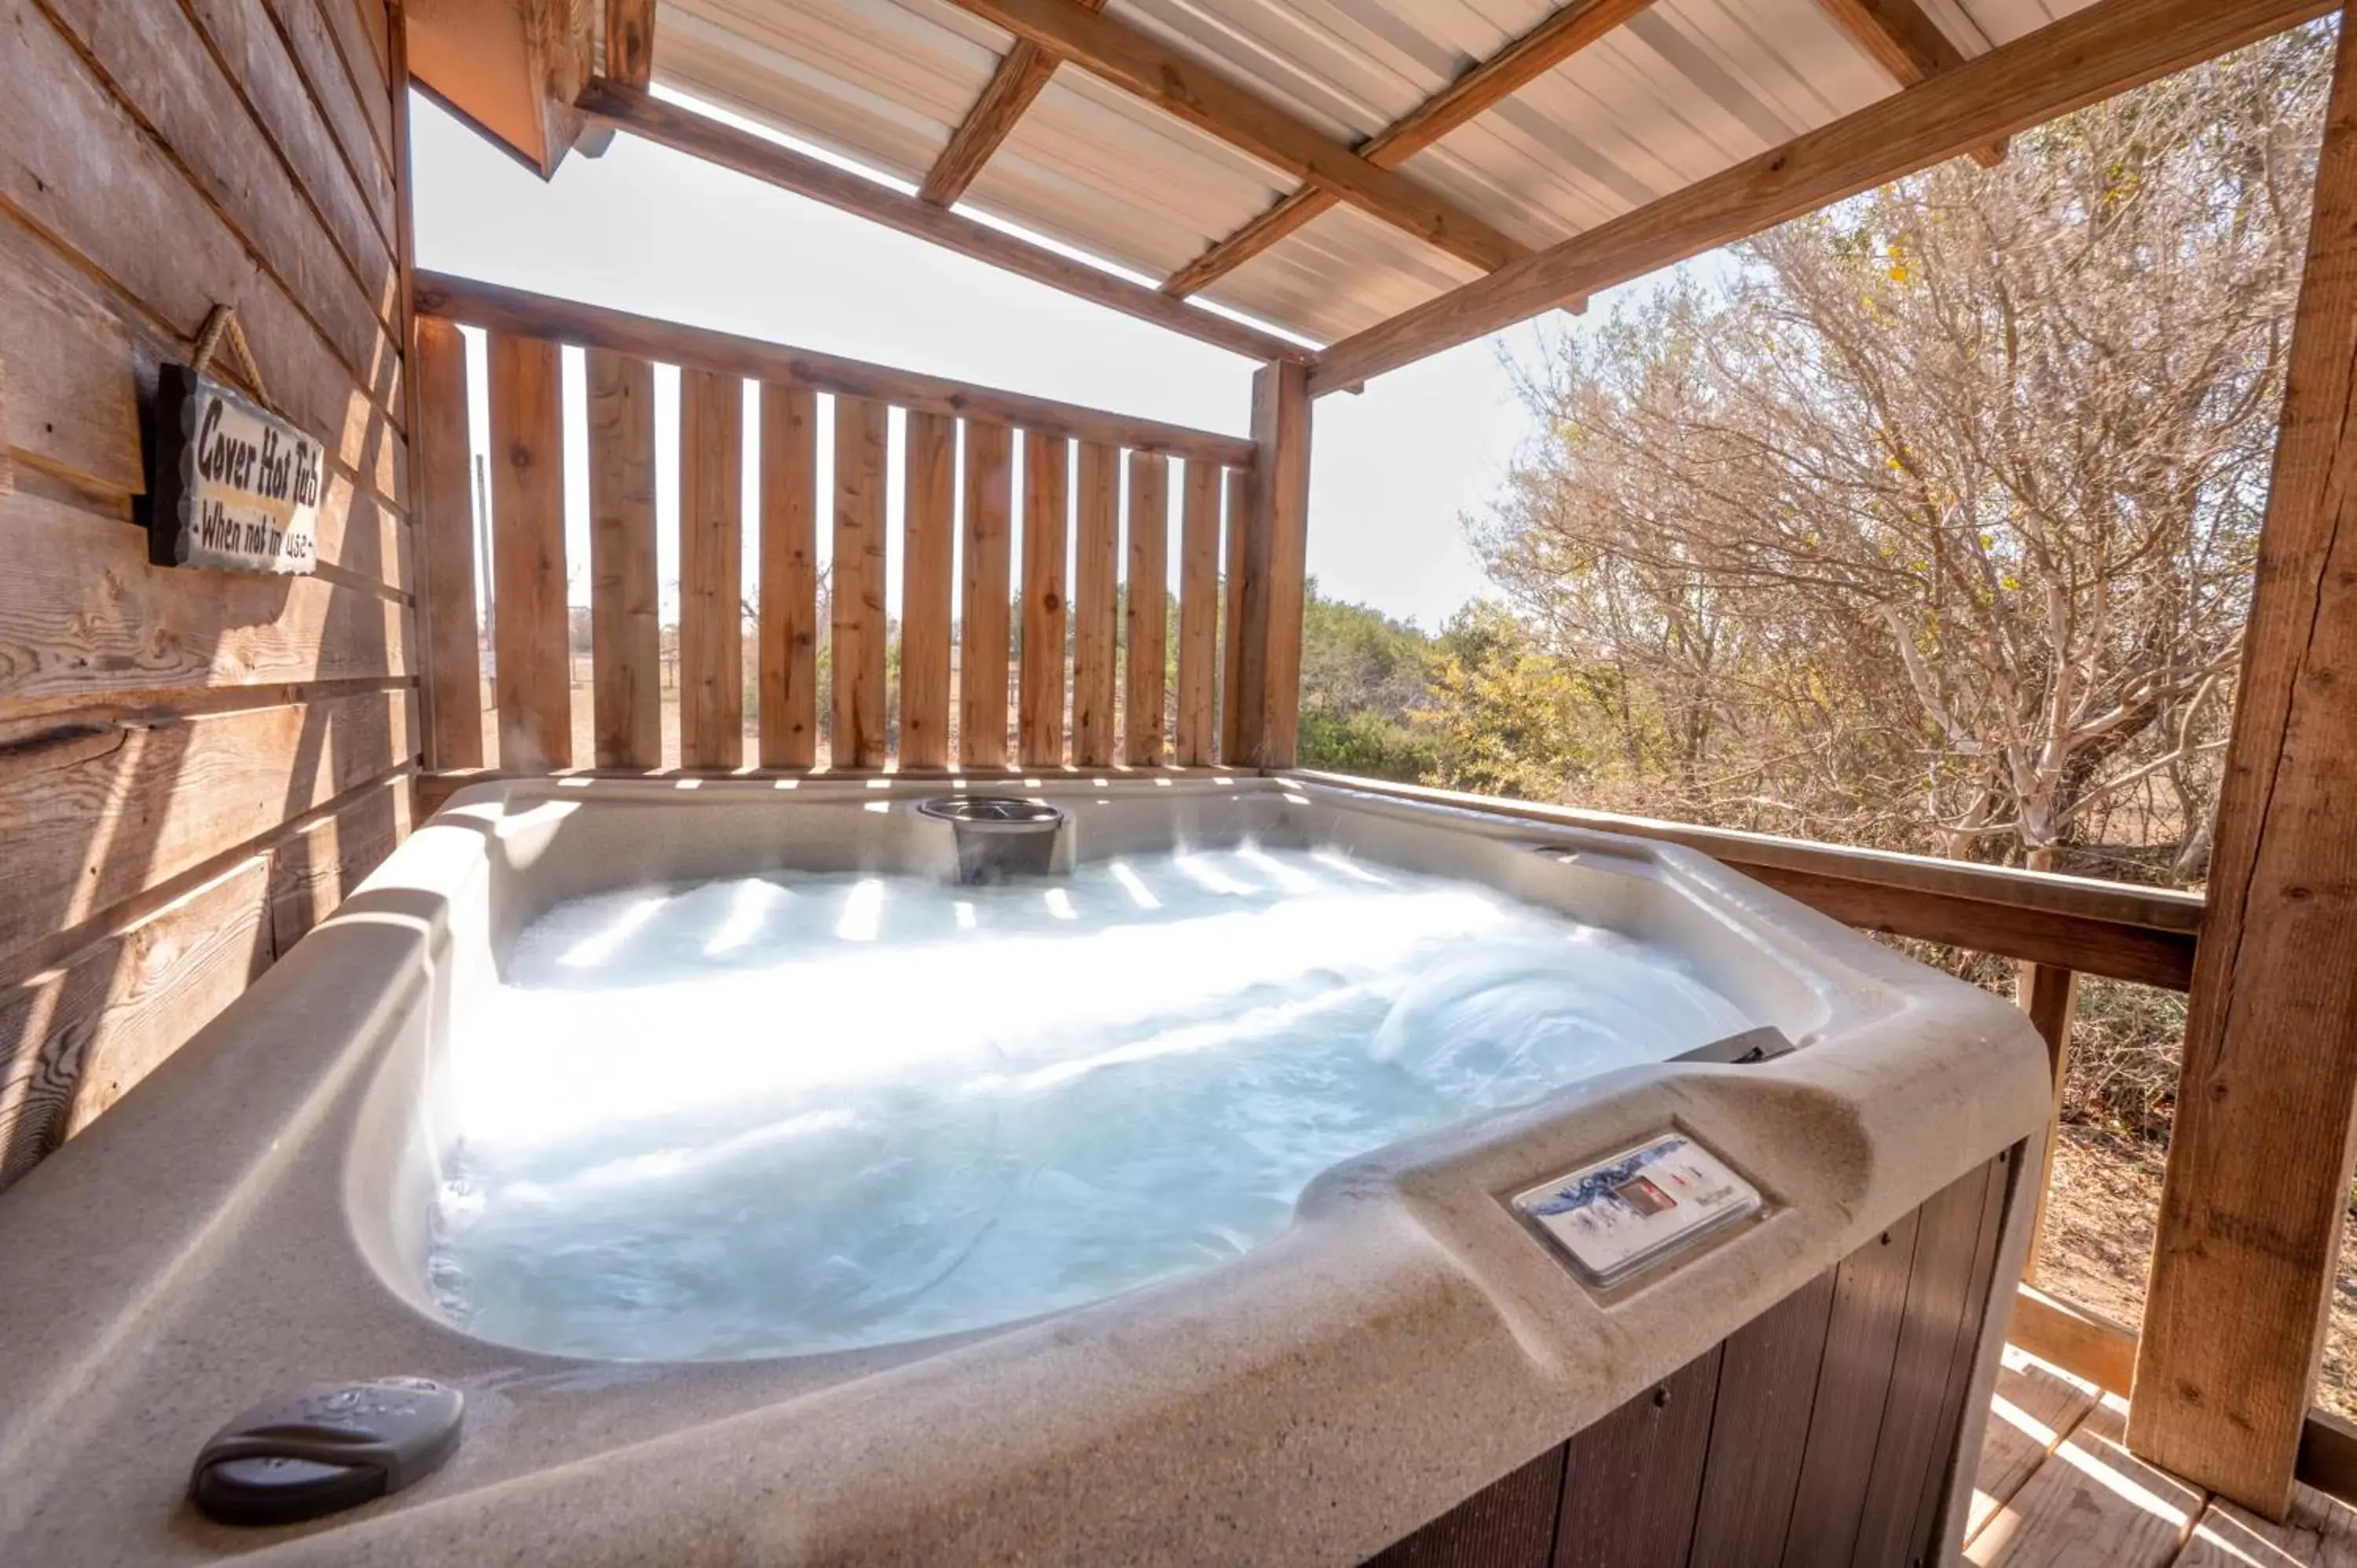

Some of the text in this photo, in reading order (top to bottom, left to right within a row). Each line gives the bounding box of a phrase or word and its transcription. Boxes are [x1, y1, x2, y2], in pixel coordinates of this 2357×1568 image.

[198, 396, 317, 508] Cover Hot Tub
[244, 515, 266, 555] not
[268, 518, 281, 556] in
